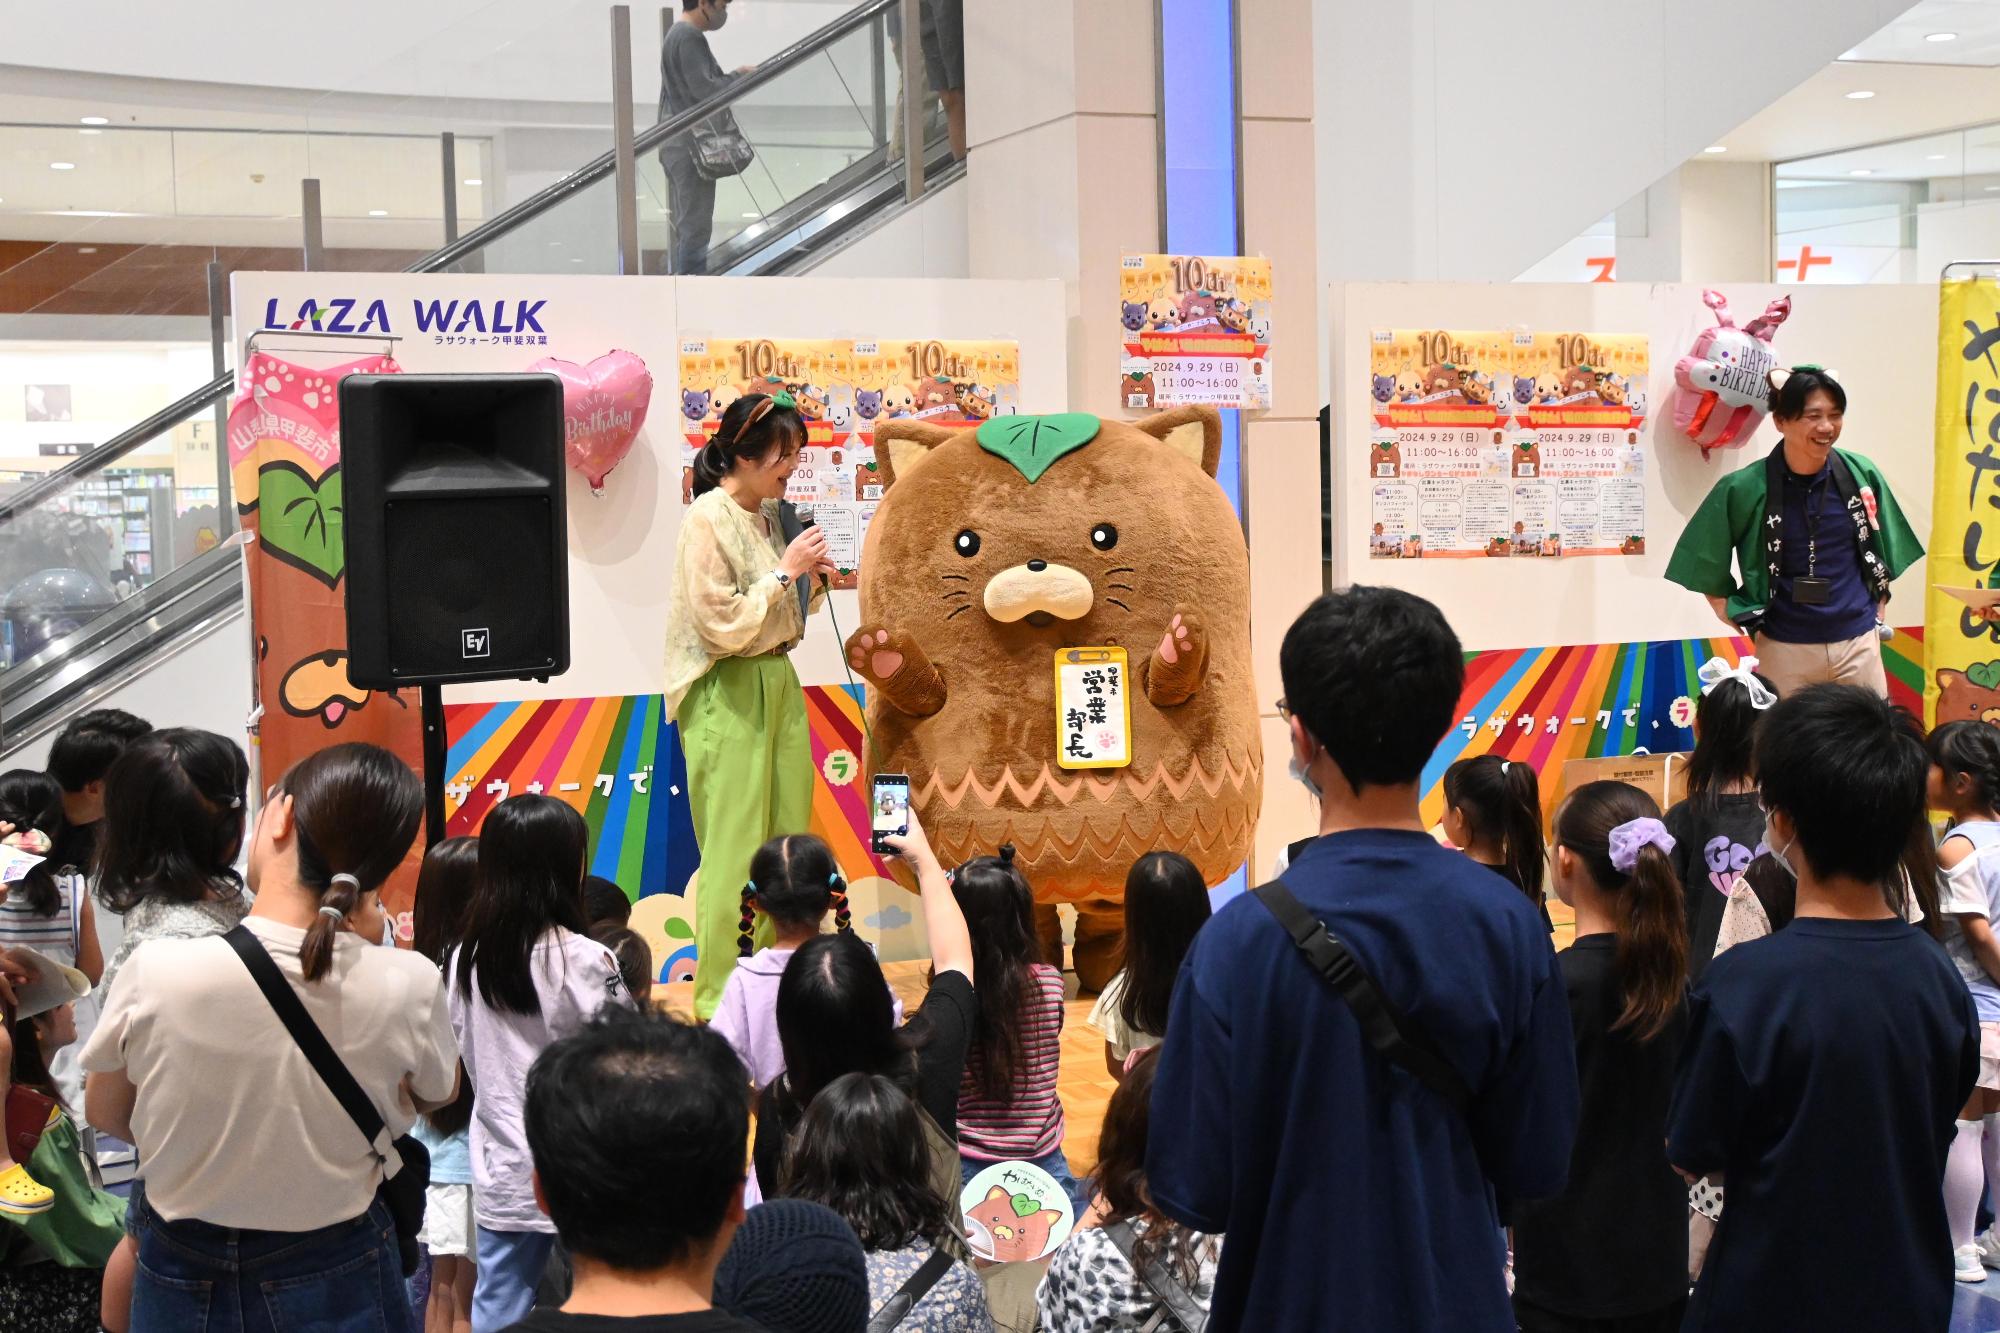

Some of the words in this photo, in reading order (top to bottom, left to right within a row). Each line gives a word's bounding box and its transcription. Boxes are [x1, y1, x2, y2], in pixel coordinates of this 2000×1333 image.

[1170, 256, 1227, 293] 10th
[265, 298, 391, 332] LAZA
[413, 299, 548, 332] WALK
[735, 339, 801, 379] 10th
[905, 340, 968, 379] 10th
[1417, 330, 1471, 367] 10th
[1558, 332, 1606, 368] 10th
[231, 414, 332, 462] 山梨県甲斐市
[565, 407, 632, 441] Birthday
[1704, 835, 1772, 873] GO
